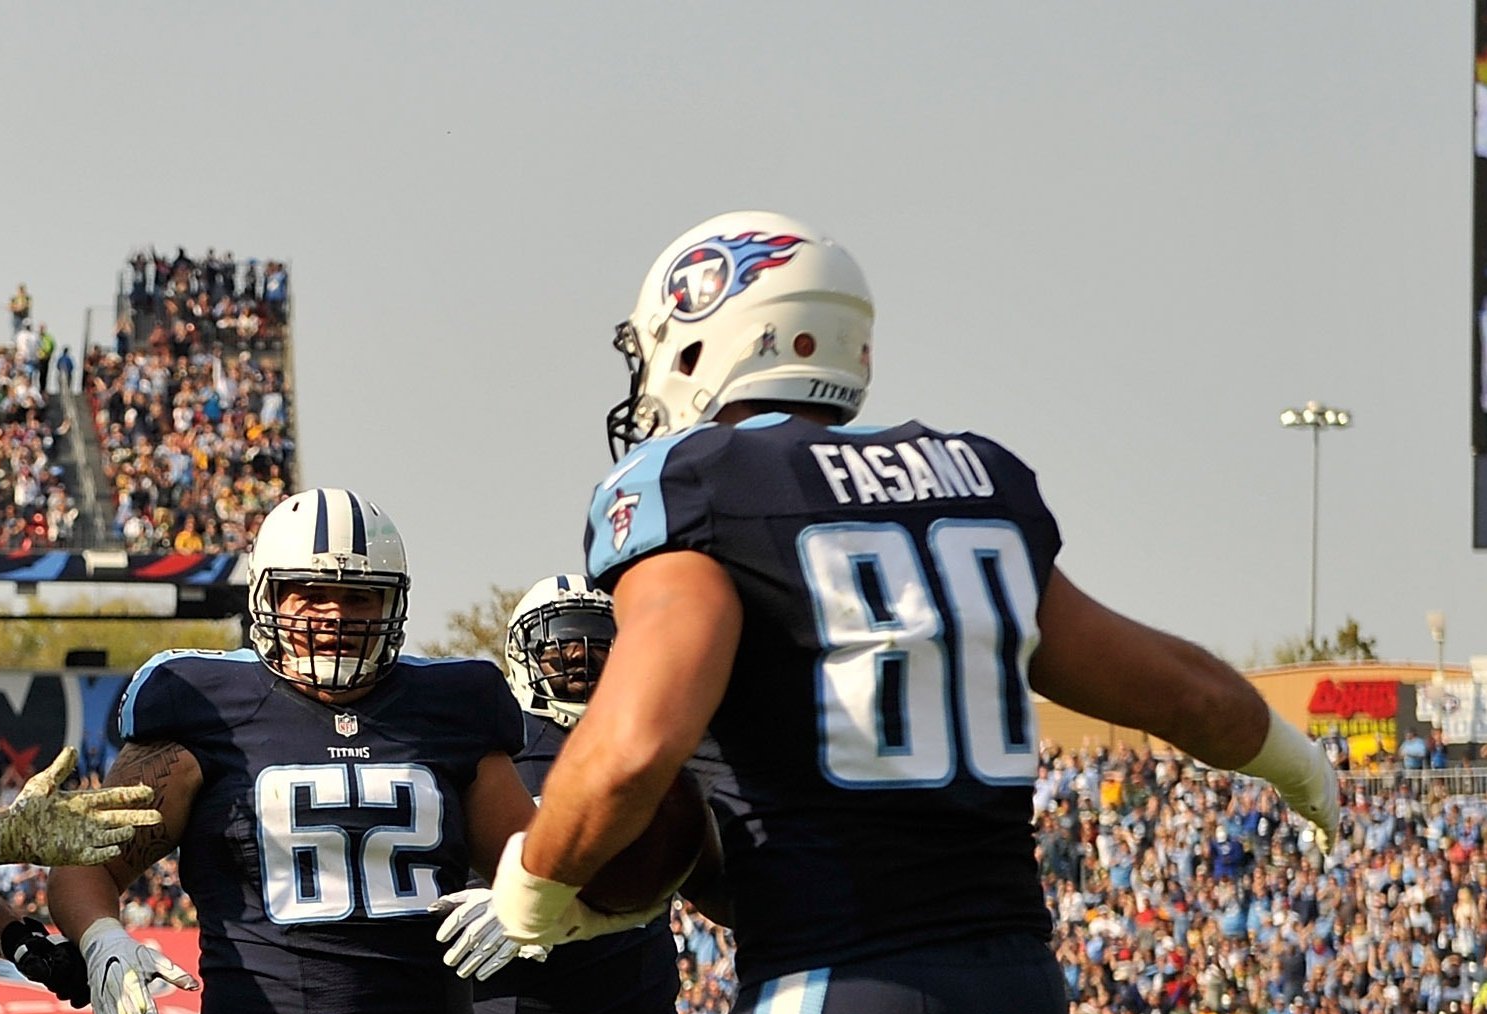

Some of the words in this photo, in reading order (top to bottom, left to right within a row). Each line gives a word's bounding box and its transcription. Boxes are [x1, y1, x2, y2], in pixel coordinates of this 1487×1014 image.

[809, 437, 995, 504] FASANO
[796, 517, 1041, 790] 80
[326, 746, 371, 760] TITANS
[254, 762, 445, 926] 62
